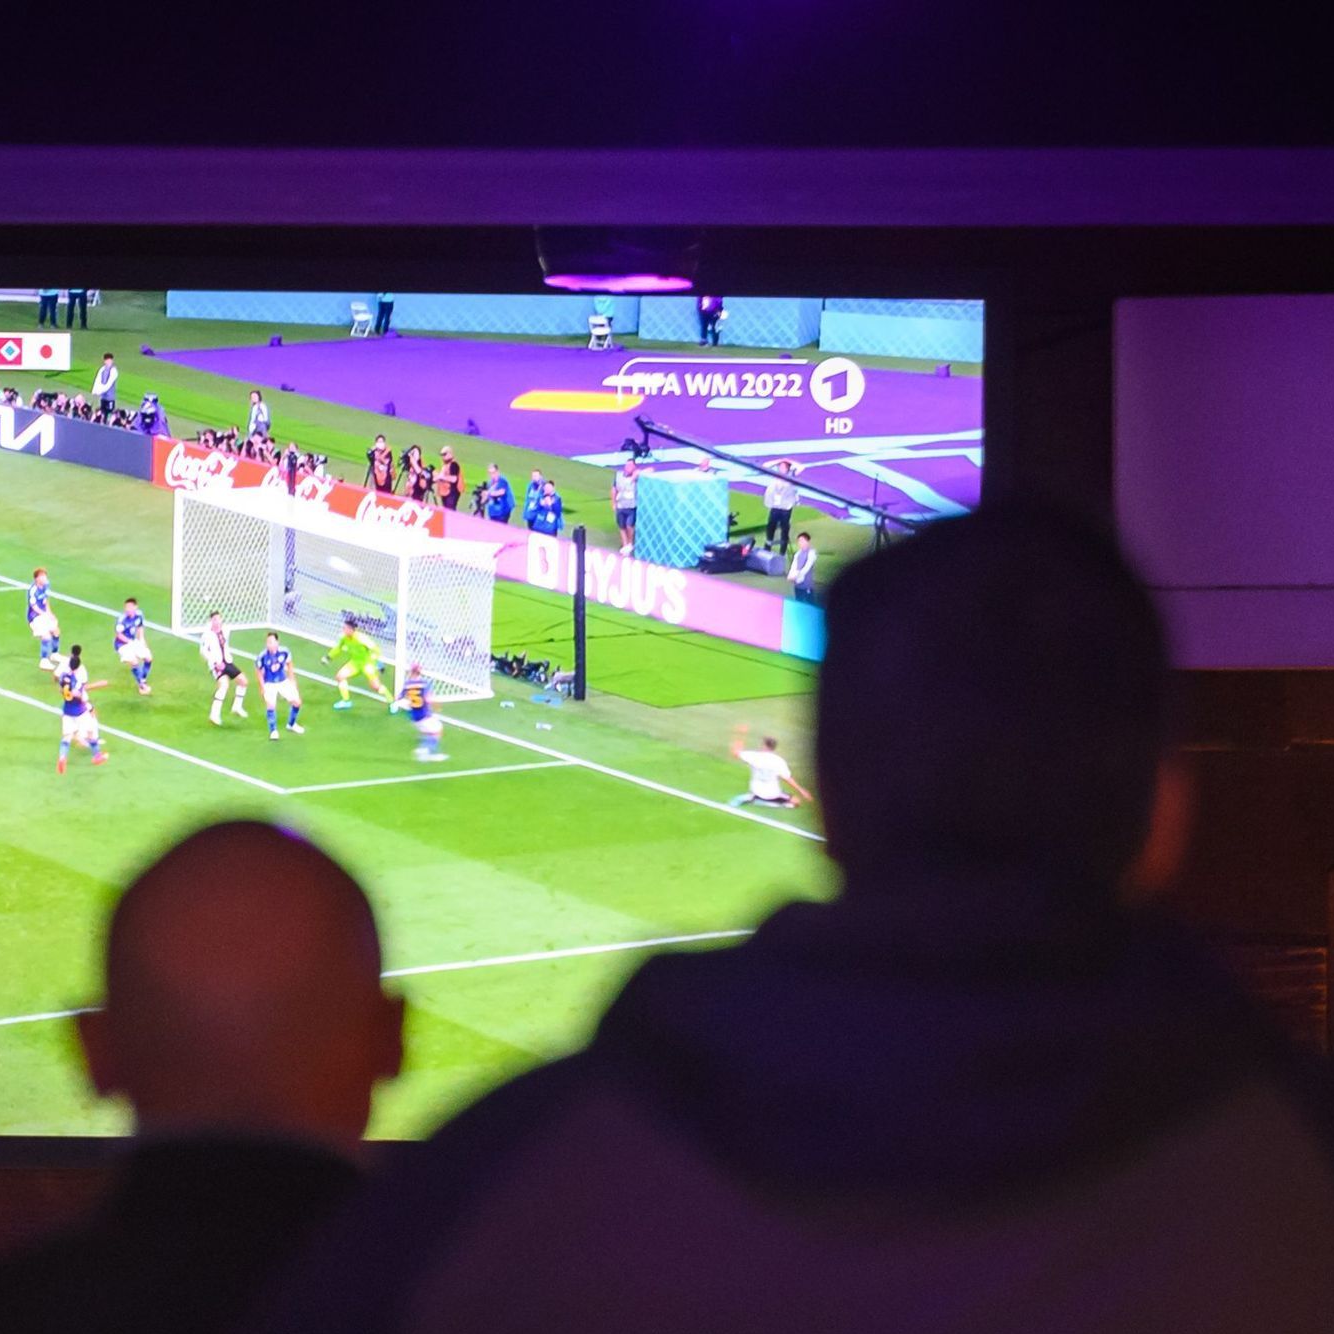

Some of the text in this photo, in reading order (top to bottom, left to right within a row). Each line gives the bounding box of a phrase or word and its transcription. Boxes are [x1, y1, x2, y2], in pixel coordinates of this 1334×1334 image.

[683, 373, 738, 397] WM
[740, 373, 804, 398] 2022
[824, 417, 854, 435] HD
